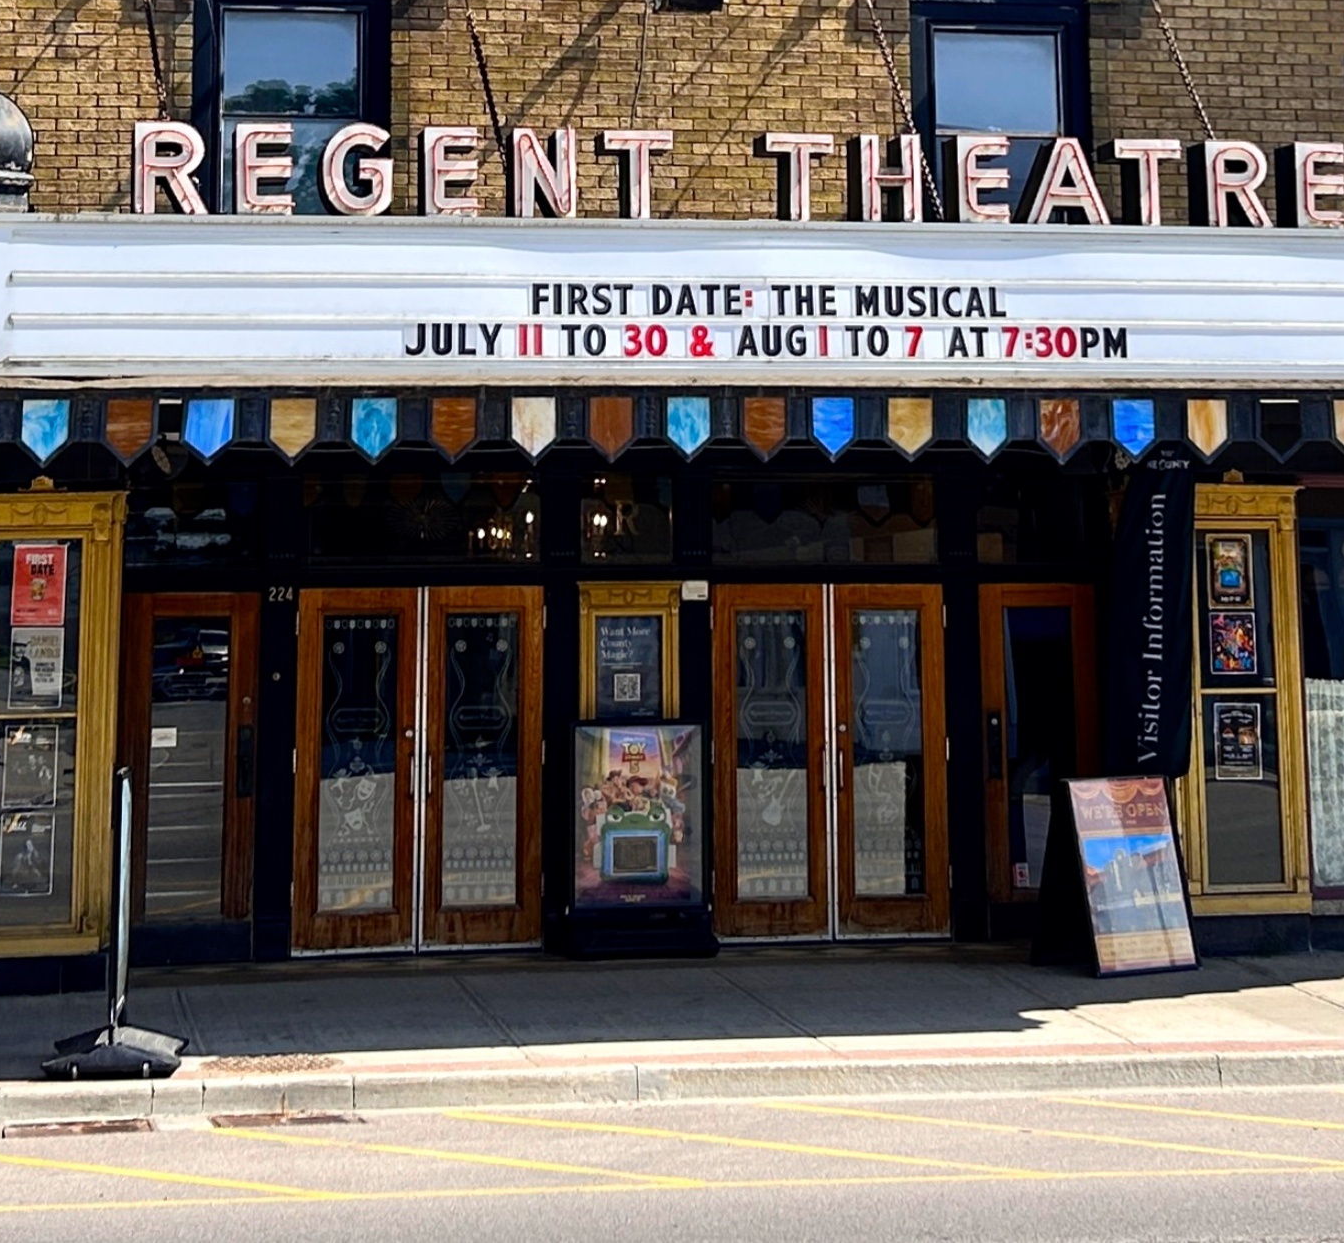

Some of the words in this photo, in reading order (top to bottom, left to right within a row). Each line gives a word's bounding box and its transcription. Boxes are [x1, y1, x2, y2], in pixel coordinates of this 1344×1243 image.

[133, 120, 674, 219] REGENT
[531, 282, 634, 316] FIRST
[651, 283, 753, 317] DATE:
[771, 284, 837, 317] THE
[856, 284, 1007, 318] MUSICAL
[405, 322, 503, 356] JULY
[561, 323, 607, 357] TO
[623, 323, 668, 357] 30
[689, 324, 715, 357] &
[736, 324, 807, 357] AUG
[817, 325, 828, 357] 1
[845, 324, 890, 357] TO
[903, 325, 924, 357] 7
[947, 325, 989, 357] AT
[1000, 325, 1129, 358] 7:30PM
[25, 553, 55, 565] FIRST
[30, 564, 55, 576] DATE
[1142, 493, 1167, 661] Information
[268, 586, 294, 602] 224
[600, 626, 625, 637] Want
[627, 626, 652, 636] More
[600, 638, 633, 650] County
[601, 649, 634, 662] Magic?
[1137, 669, 1162, 763] Visitor
[622, 742, 646, 755] TOY
[1082, 805, 1123, 820] WE'RE
[1127, 802, 1166, 817] OPEN
